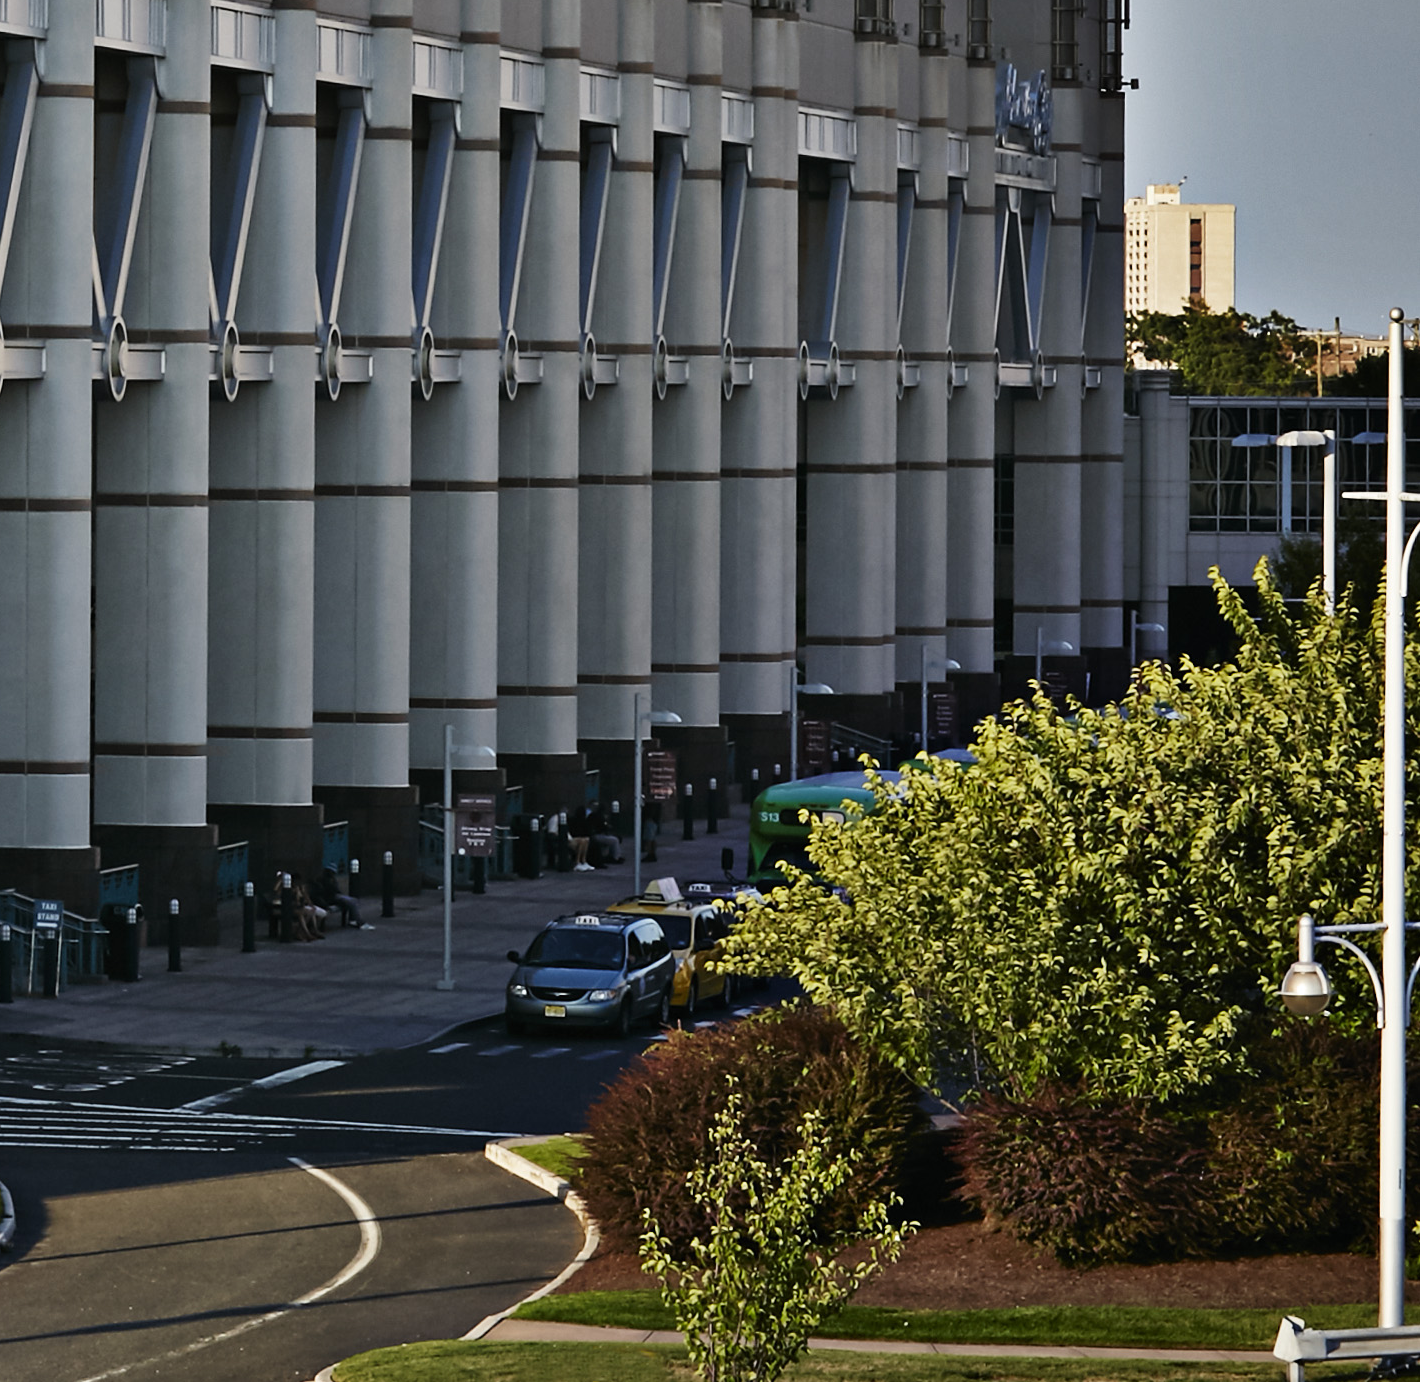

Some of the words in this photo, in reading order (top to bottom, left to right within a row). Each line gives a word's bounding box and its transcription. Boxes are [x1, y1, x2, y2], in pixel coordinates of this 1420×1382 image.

[761, 812, 780, 823] S13
[41, 902, 58, 910] TAXI
[37, 912, 60, 921] STAND
